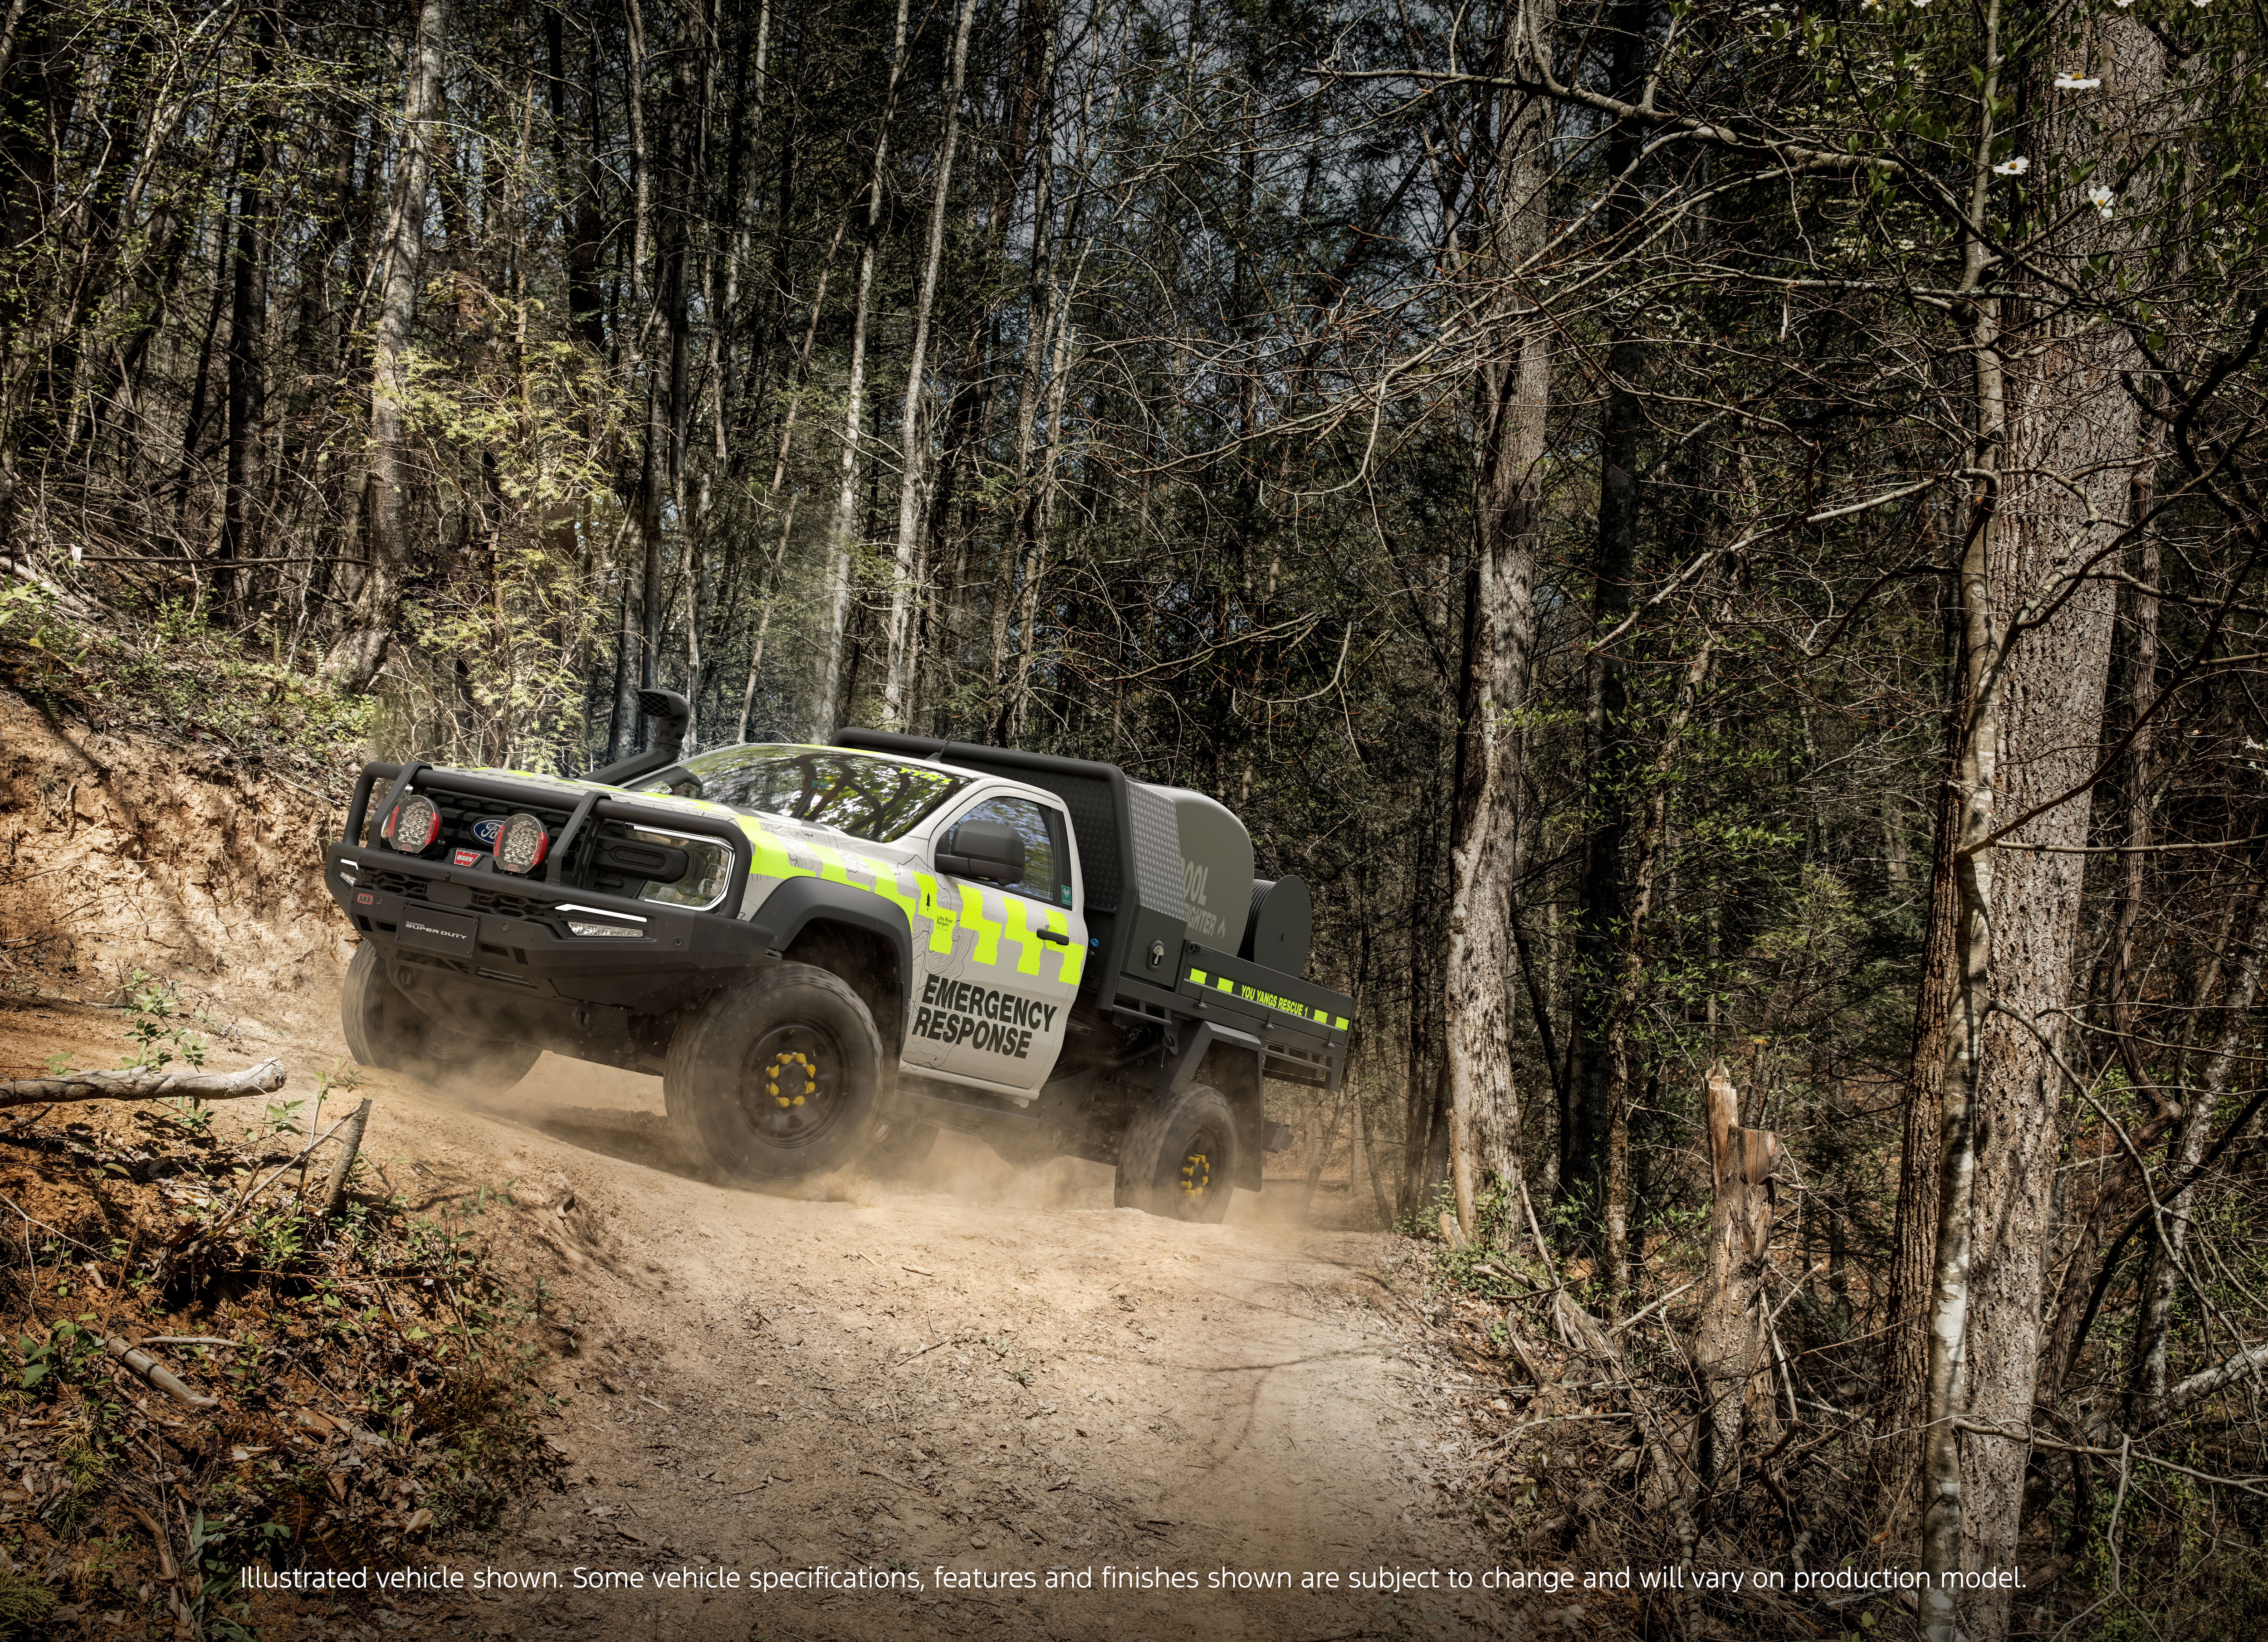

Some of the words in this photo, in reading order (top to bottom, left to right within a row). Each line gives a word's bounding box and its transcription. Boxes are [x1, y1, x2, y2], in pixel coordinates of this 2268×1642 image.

[899, 767, 953, 784] YYR1
[406, 924, 439, 934] SUPER
[440, 931, 467, 939] DUTY
[921, 974, 1058, 1032] EMERGENCY
[1242, 984, 1256, 1000] YOU
[1256, 989, 1277, 1008] YANGS
[1277, 997, 1304, 1016] RESCUE
[1304, 1006, 1309, 1018] 1
[911, 1006, 1032, 1059] RESPONSE
